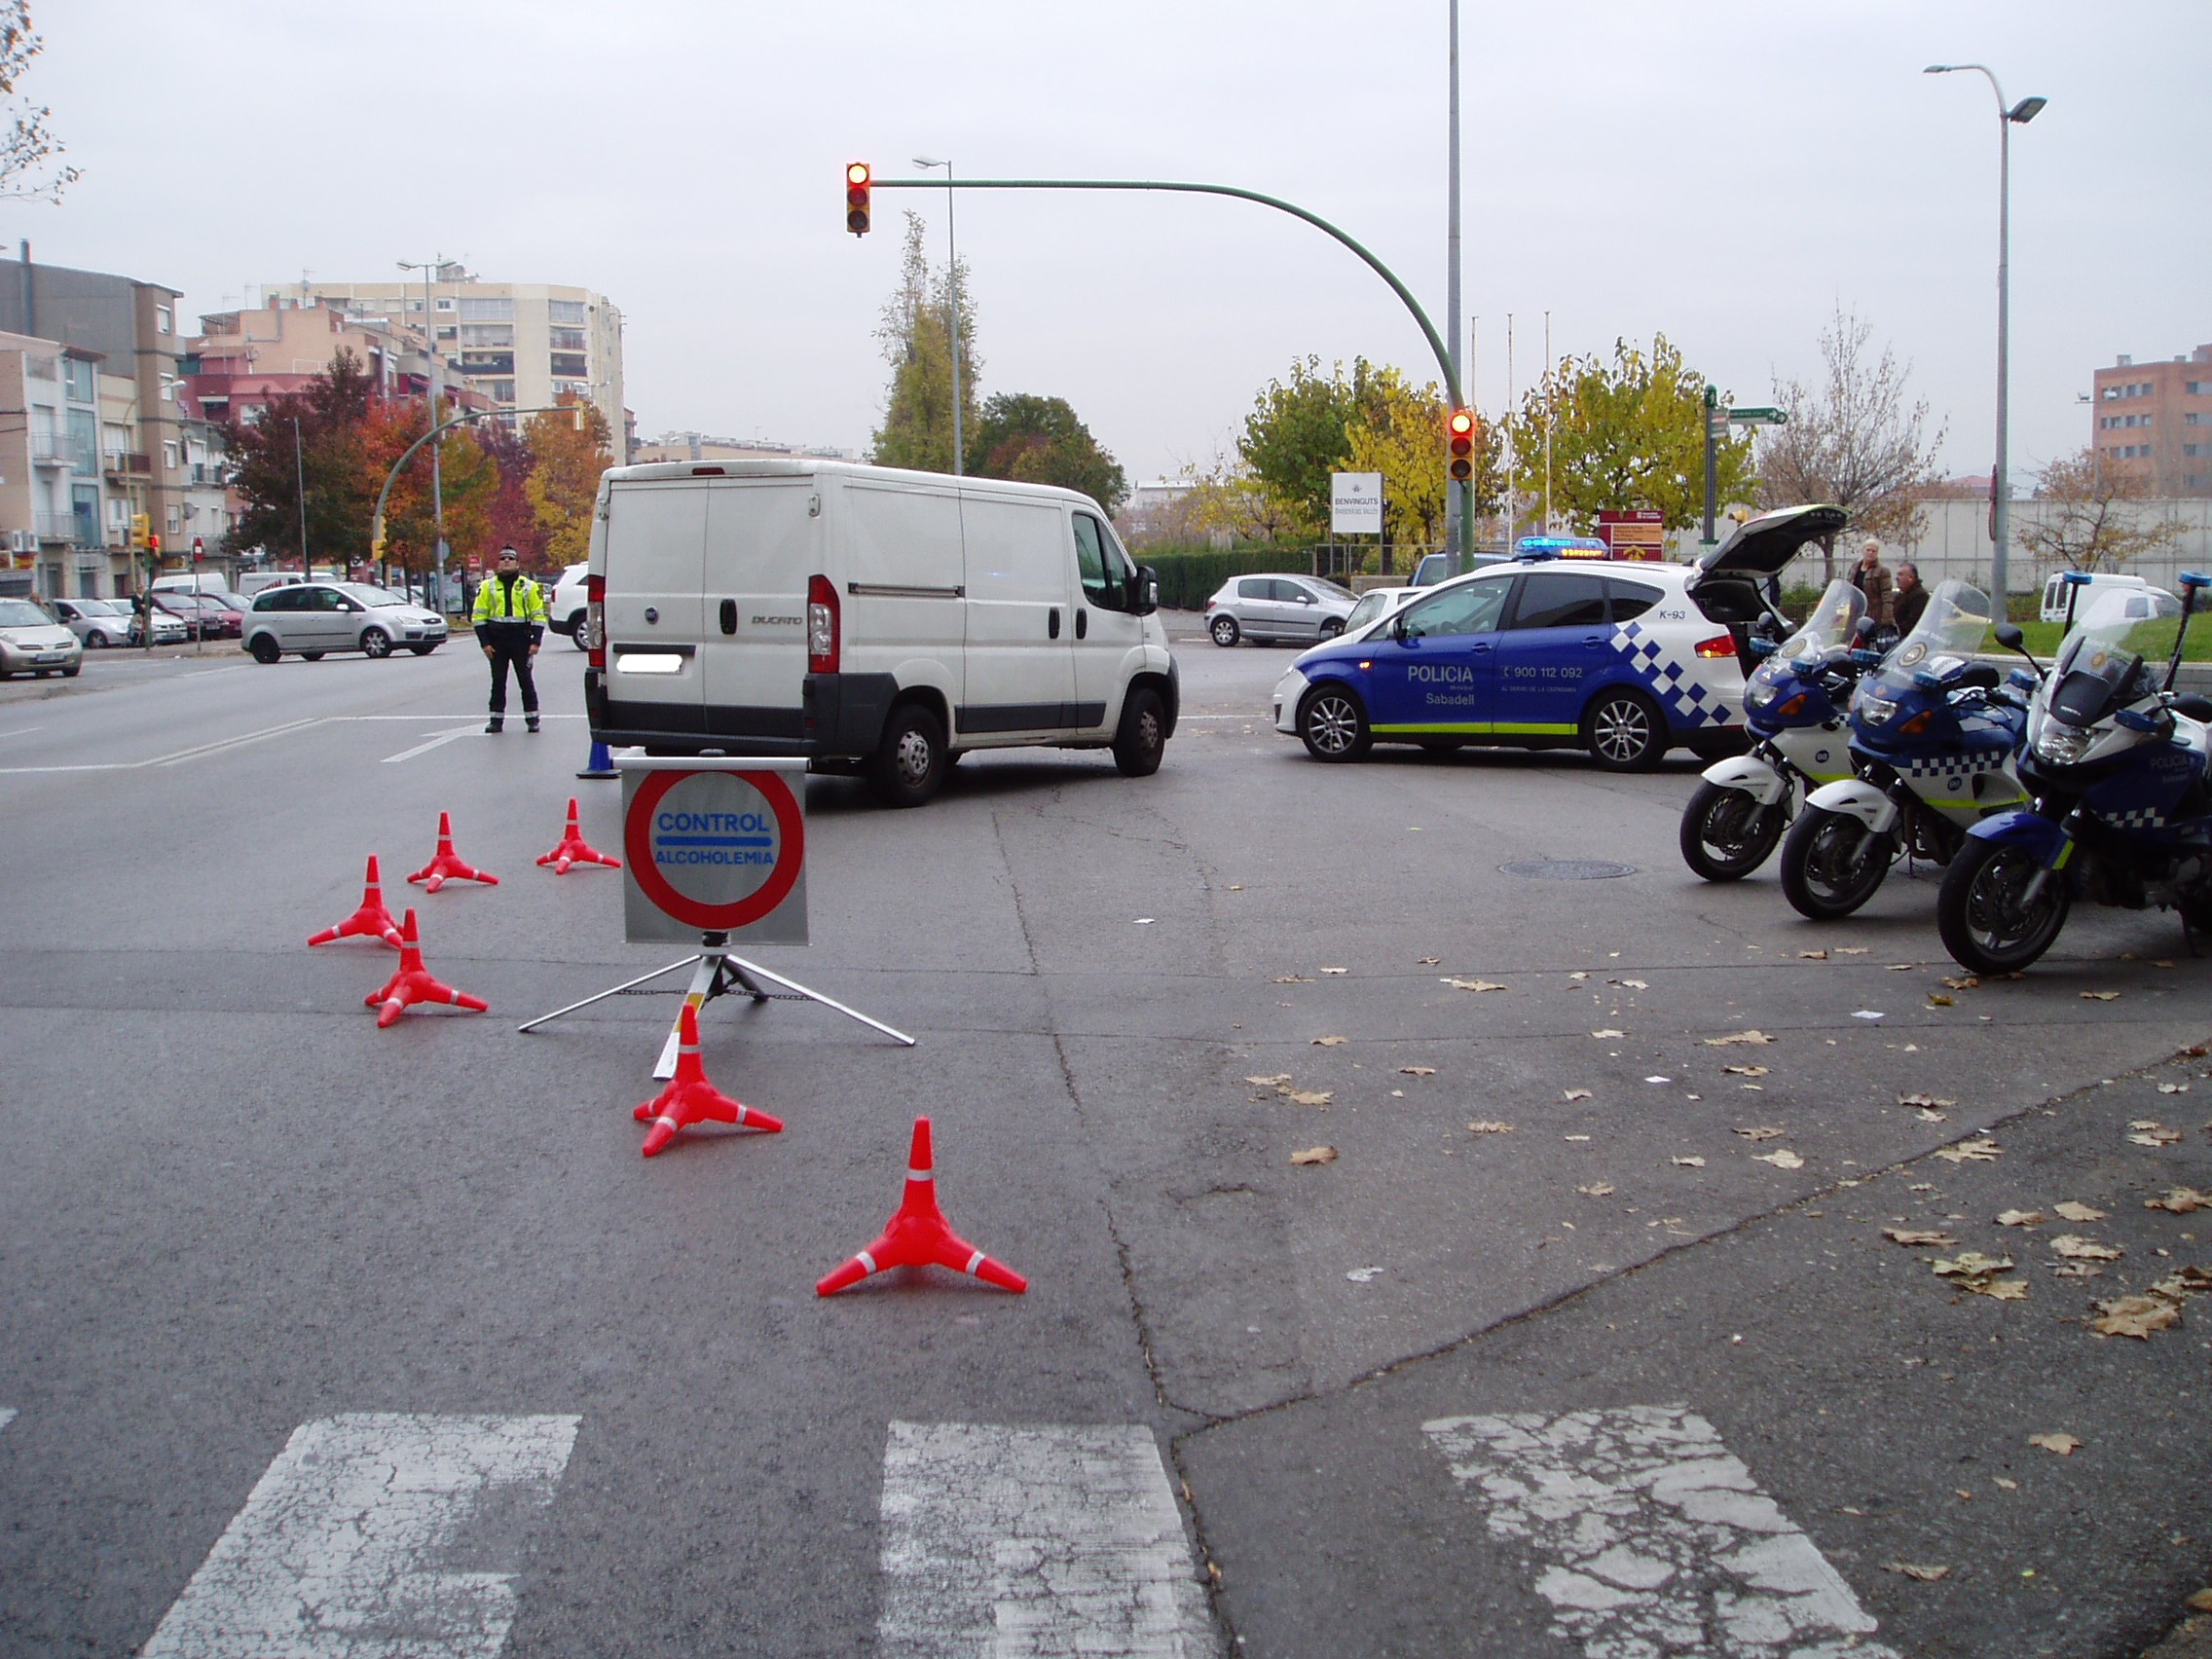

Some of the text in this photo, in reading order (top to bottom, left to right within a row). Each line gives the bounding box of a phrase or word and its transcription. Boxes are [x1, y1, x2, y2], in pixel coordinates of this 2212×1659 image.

[752, 615, 803, 624] DUCATO
[1659, 609, 1686, 619] K-93
[1408, 665, 1474, 682] POLICIA
[1514, 667, 1582, 679] 900 112 092
[1426, 692, 1475, 705] Sabadell
[657, 812, 770, 831] CONTROL
[654, 850, 775, 865] ALCOHOLEMIA
